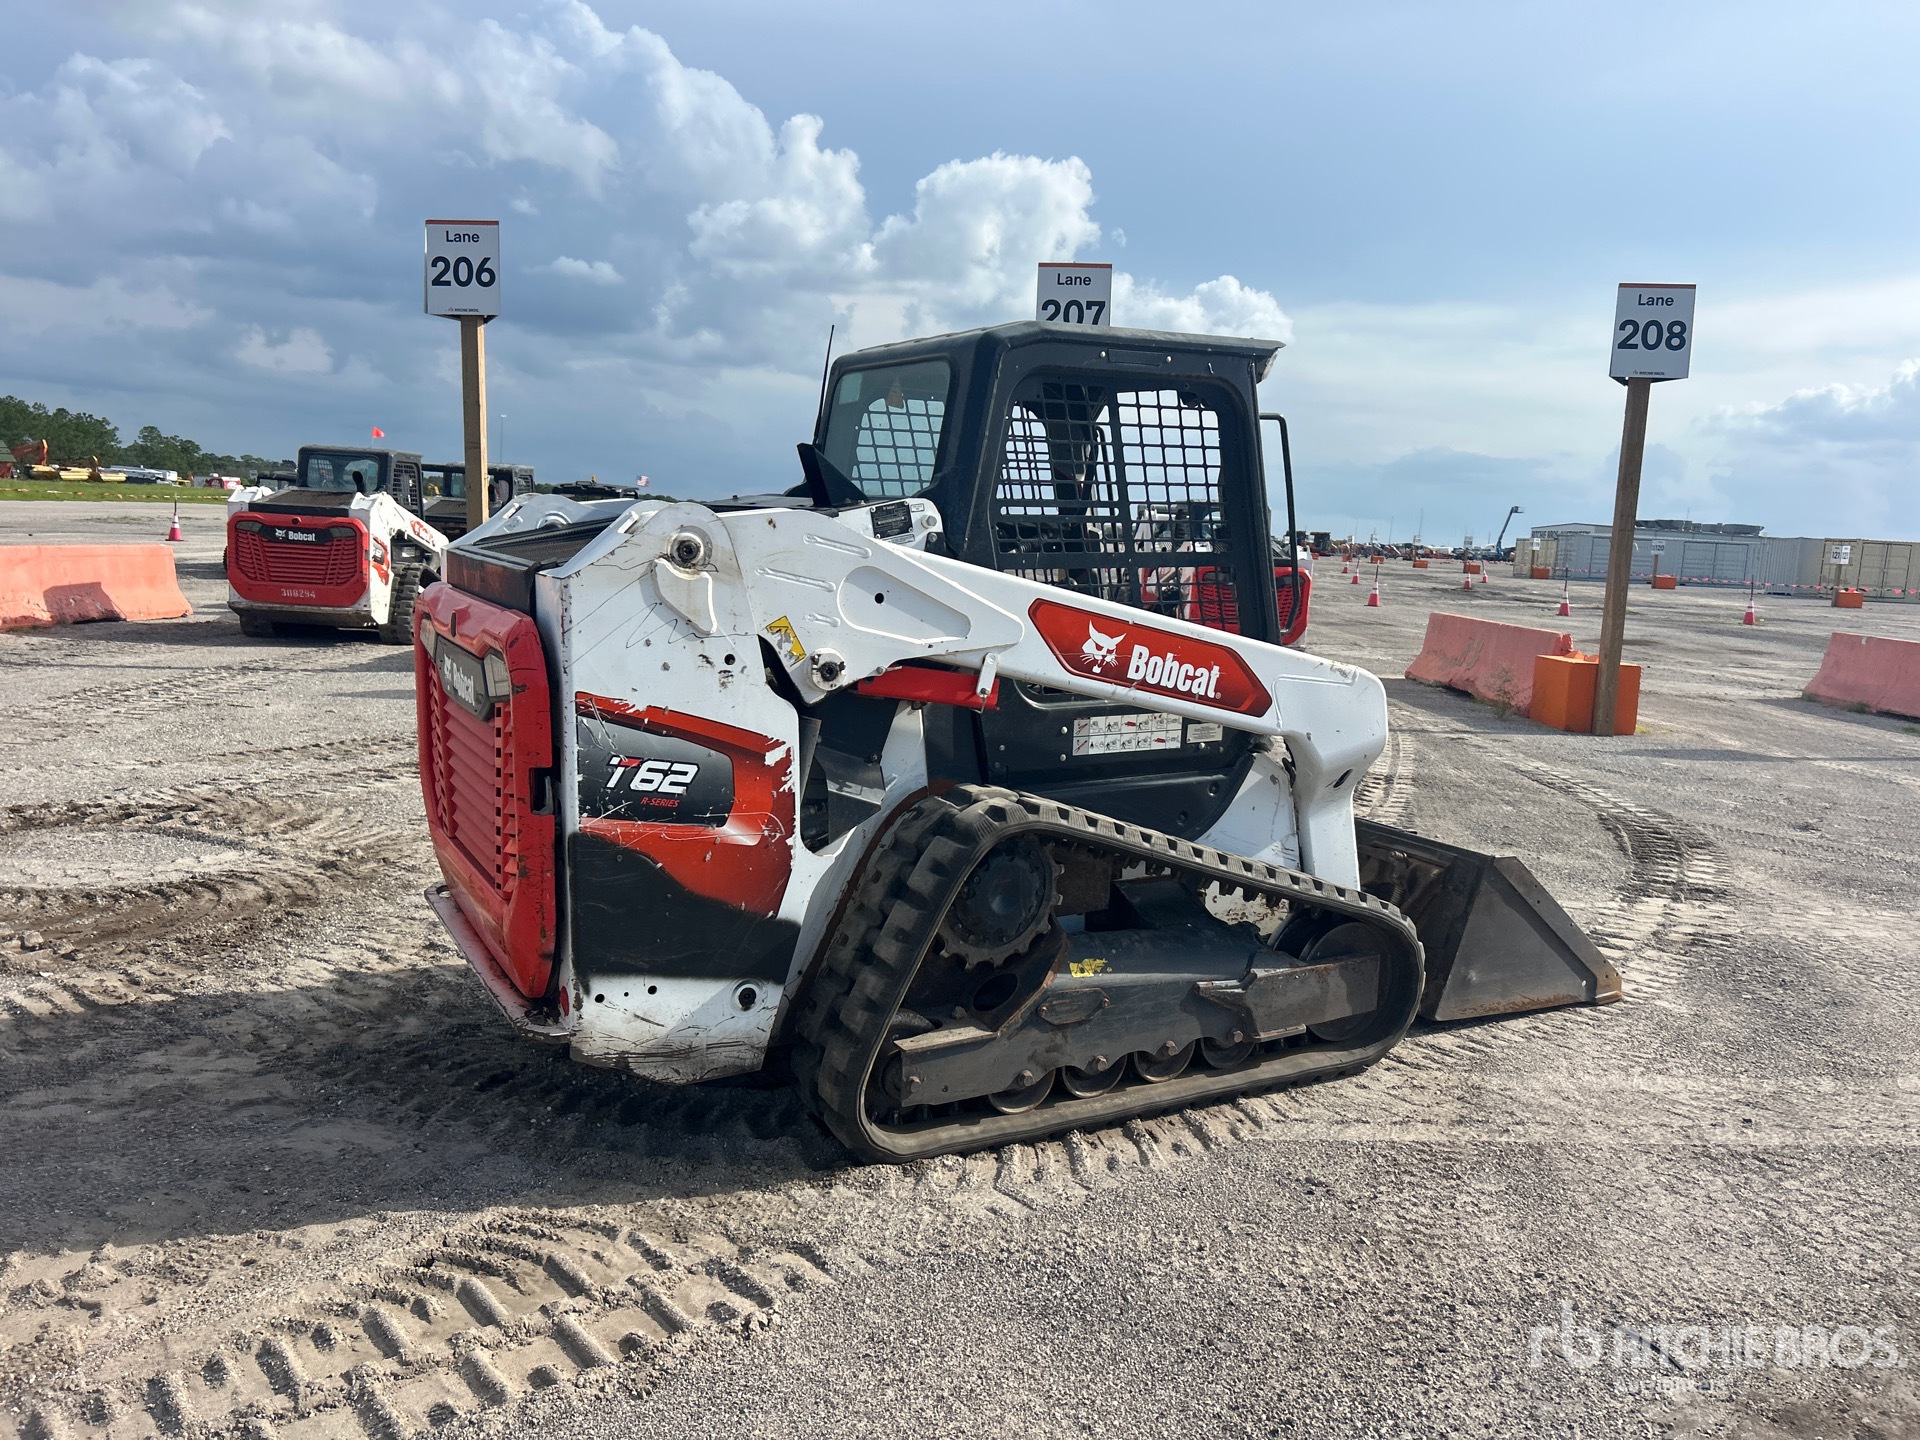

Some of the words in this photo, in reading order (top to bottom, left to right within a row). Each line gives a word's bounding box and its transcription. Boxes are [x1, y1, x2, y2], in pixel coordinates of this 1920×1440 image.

[445, 230, 480, 243] Lane
[431, 256, 496, 288] 206
[1057, 273, 1092, 286] Lane
[1637, 294, 1674, 306] Lane
[1041, 299, 1106, 325] 207
[1617, 319, 1687, 351] 208
[288, 531, 316, 541] Bobcat
[1127, 644, 1220, 699] Bobcat
[606, 756, 699, 795] T62
[640, 796, 680, 808] R-SERIES
